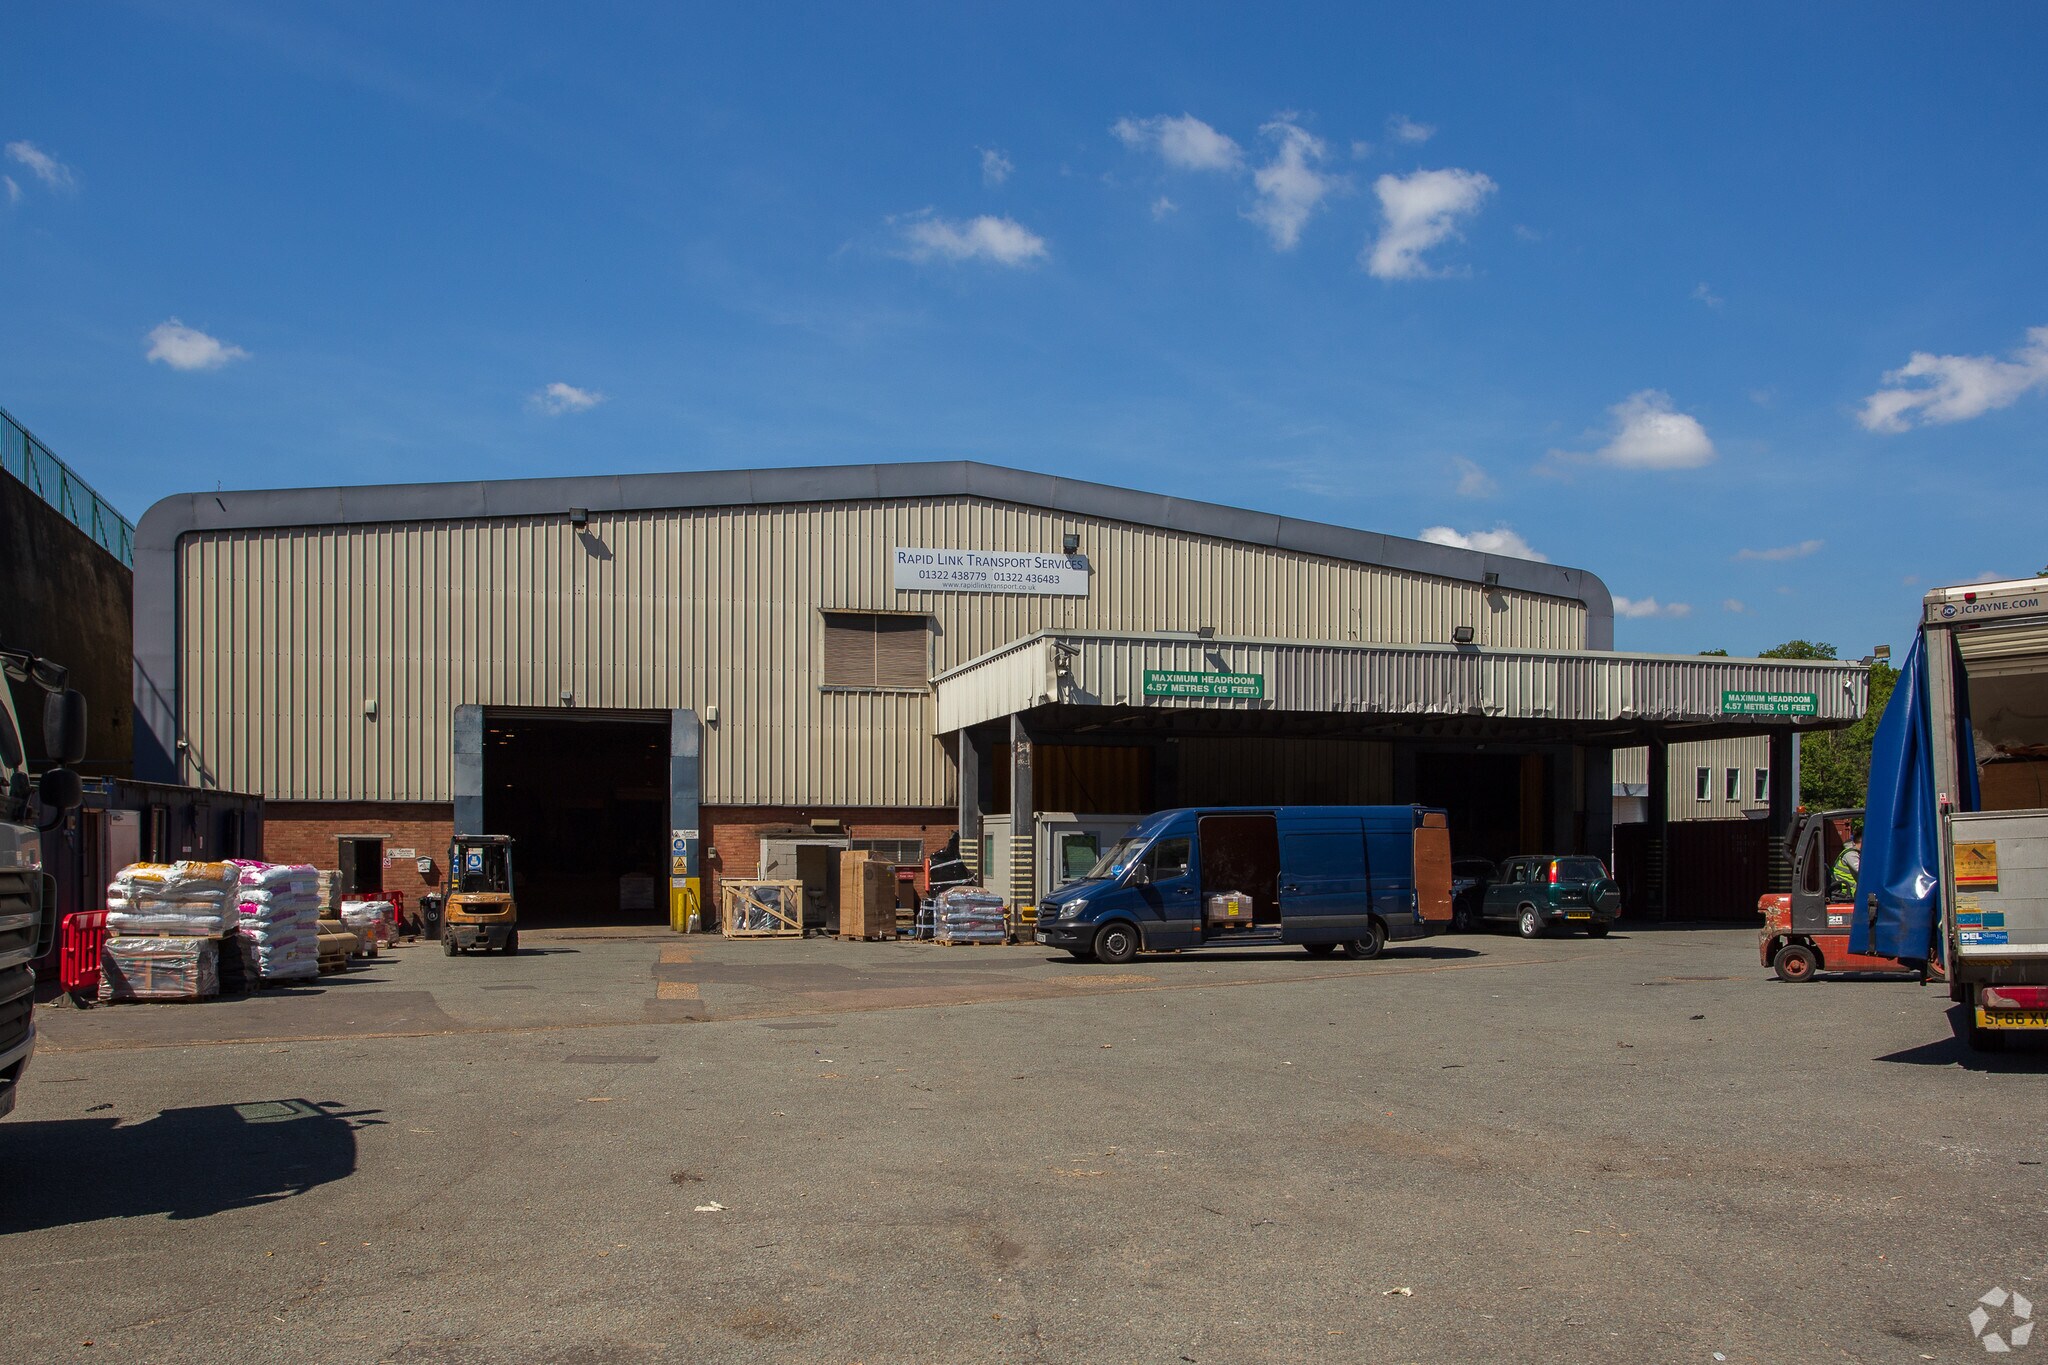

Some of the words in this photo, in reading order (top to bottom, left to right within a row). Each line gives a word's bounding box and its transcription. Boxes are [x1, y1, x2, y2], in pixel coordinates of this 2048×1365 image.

[919, 570, 949, 580] 01322
[951, 570, 987, 581] 438779
[994, 572, 1023, 582] 01322
[1025, 574, 1060, 584] 436483
[942, 582, 1036, 591] www.rapidlinktransport.couk
[1960, 598, 2039, 614] JCPAYNE.COM
[1151, 674, 1198, 683] MAXIMUM
[1201, 676, 1255, 685] HEADROOM
[1146, 683, 1168, 692] 4.57
[1171, 684, 1210, 693] METRES
[1213, 685, 1228, 694] (15
[1231, 686, 1260, 695] FEET)
[1728, 694, 1765, 702] MAXIMUM
[1767, 695, 1811, 703] HEADROOM
[1744, 703, 1775, 711] METRES
[1791, 704, 1815, 712] FEET)
[1961, 932, 1983, 940] DEL
[1985, 1012, 2024, 1025] SF66
